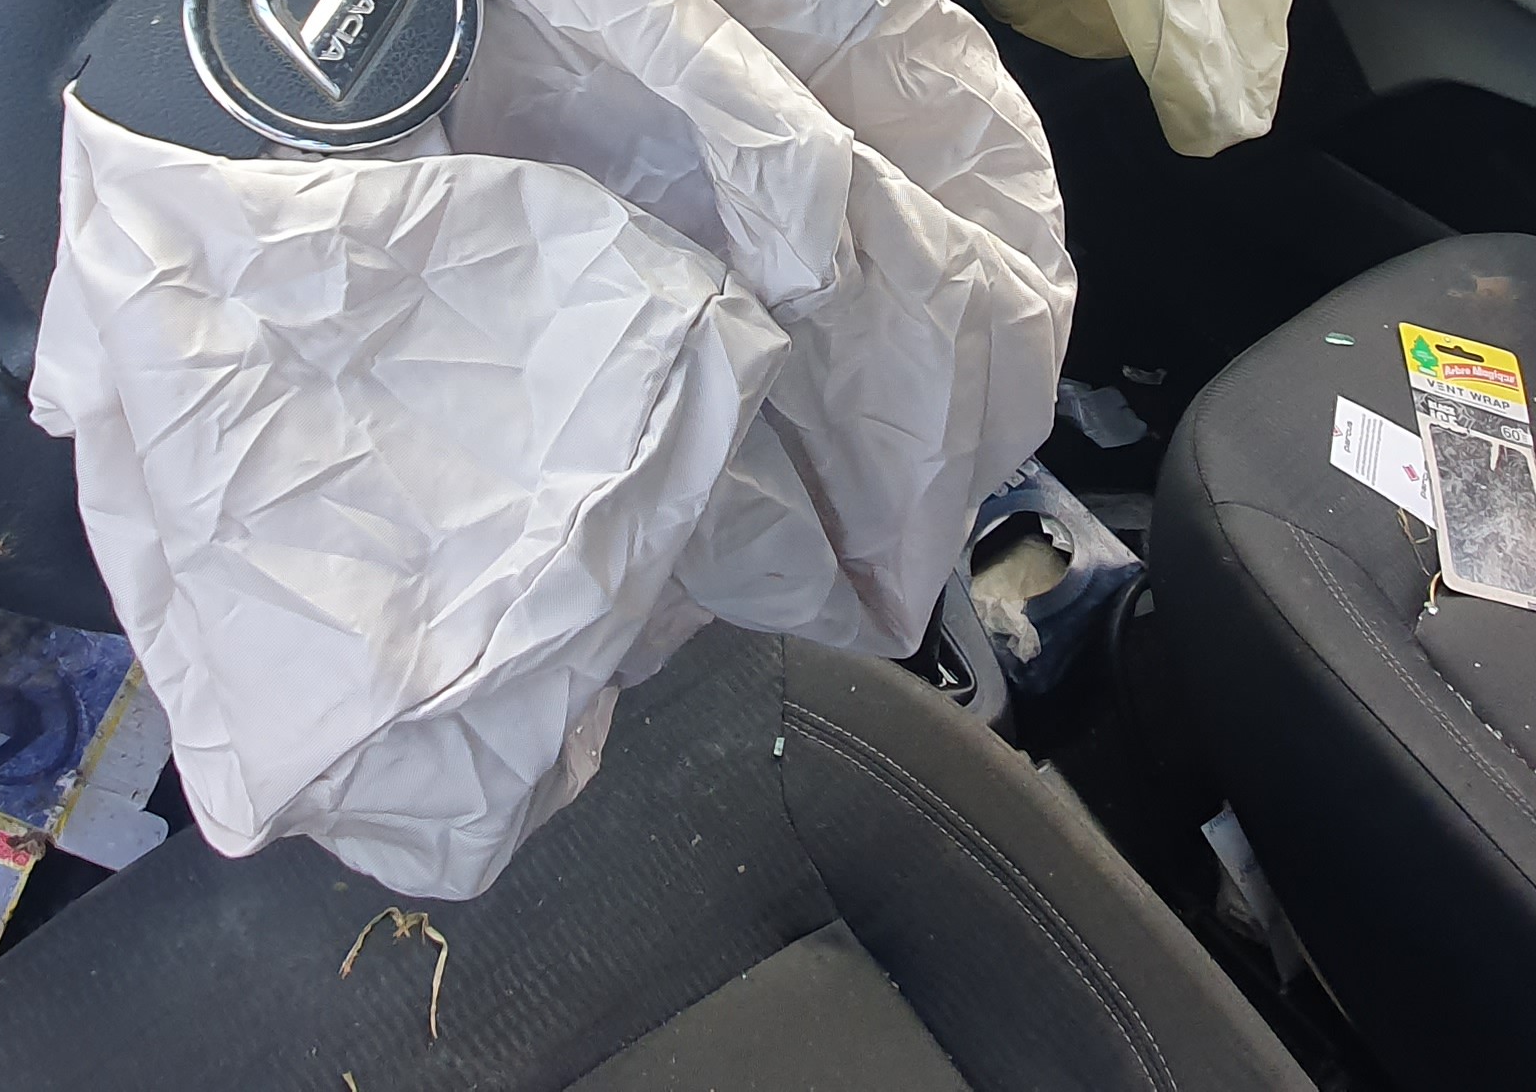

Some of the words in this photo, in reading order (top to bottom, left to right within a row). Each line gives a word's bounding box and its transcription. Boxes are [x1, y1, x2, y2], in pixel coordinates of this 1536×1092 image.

[1445, 365, 1471, 376] Arbre
[1427, 379, 1464, 396] VENT
[1470, 391, 1510, 410] WRAP
[1344, 420, 1353, 454] parcus
[1503, 427, 1520, 441] 60
